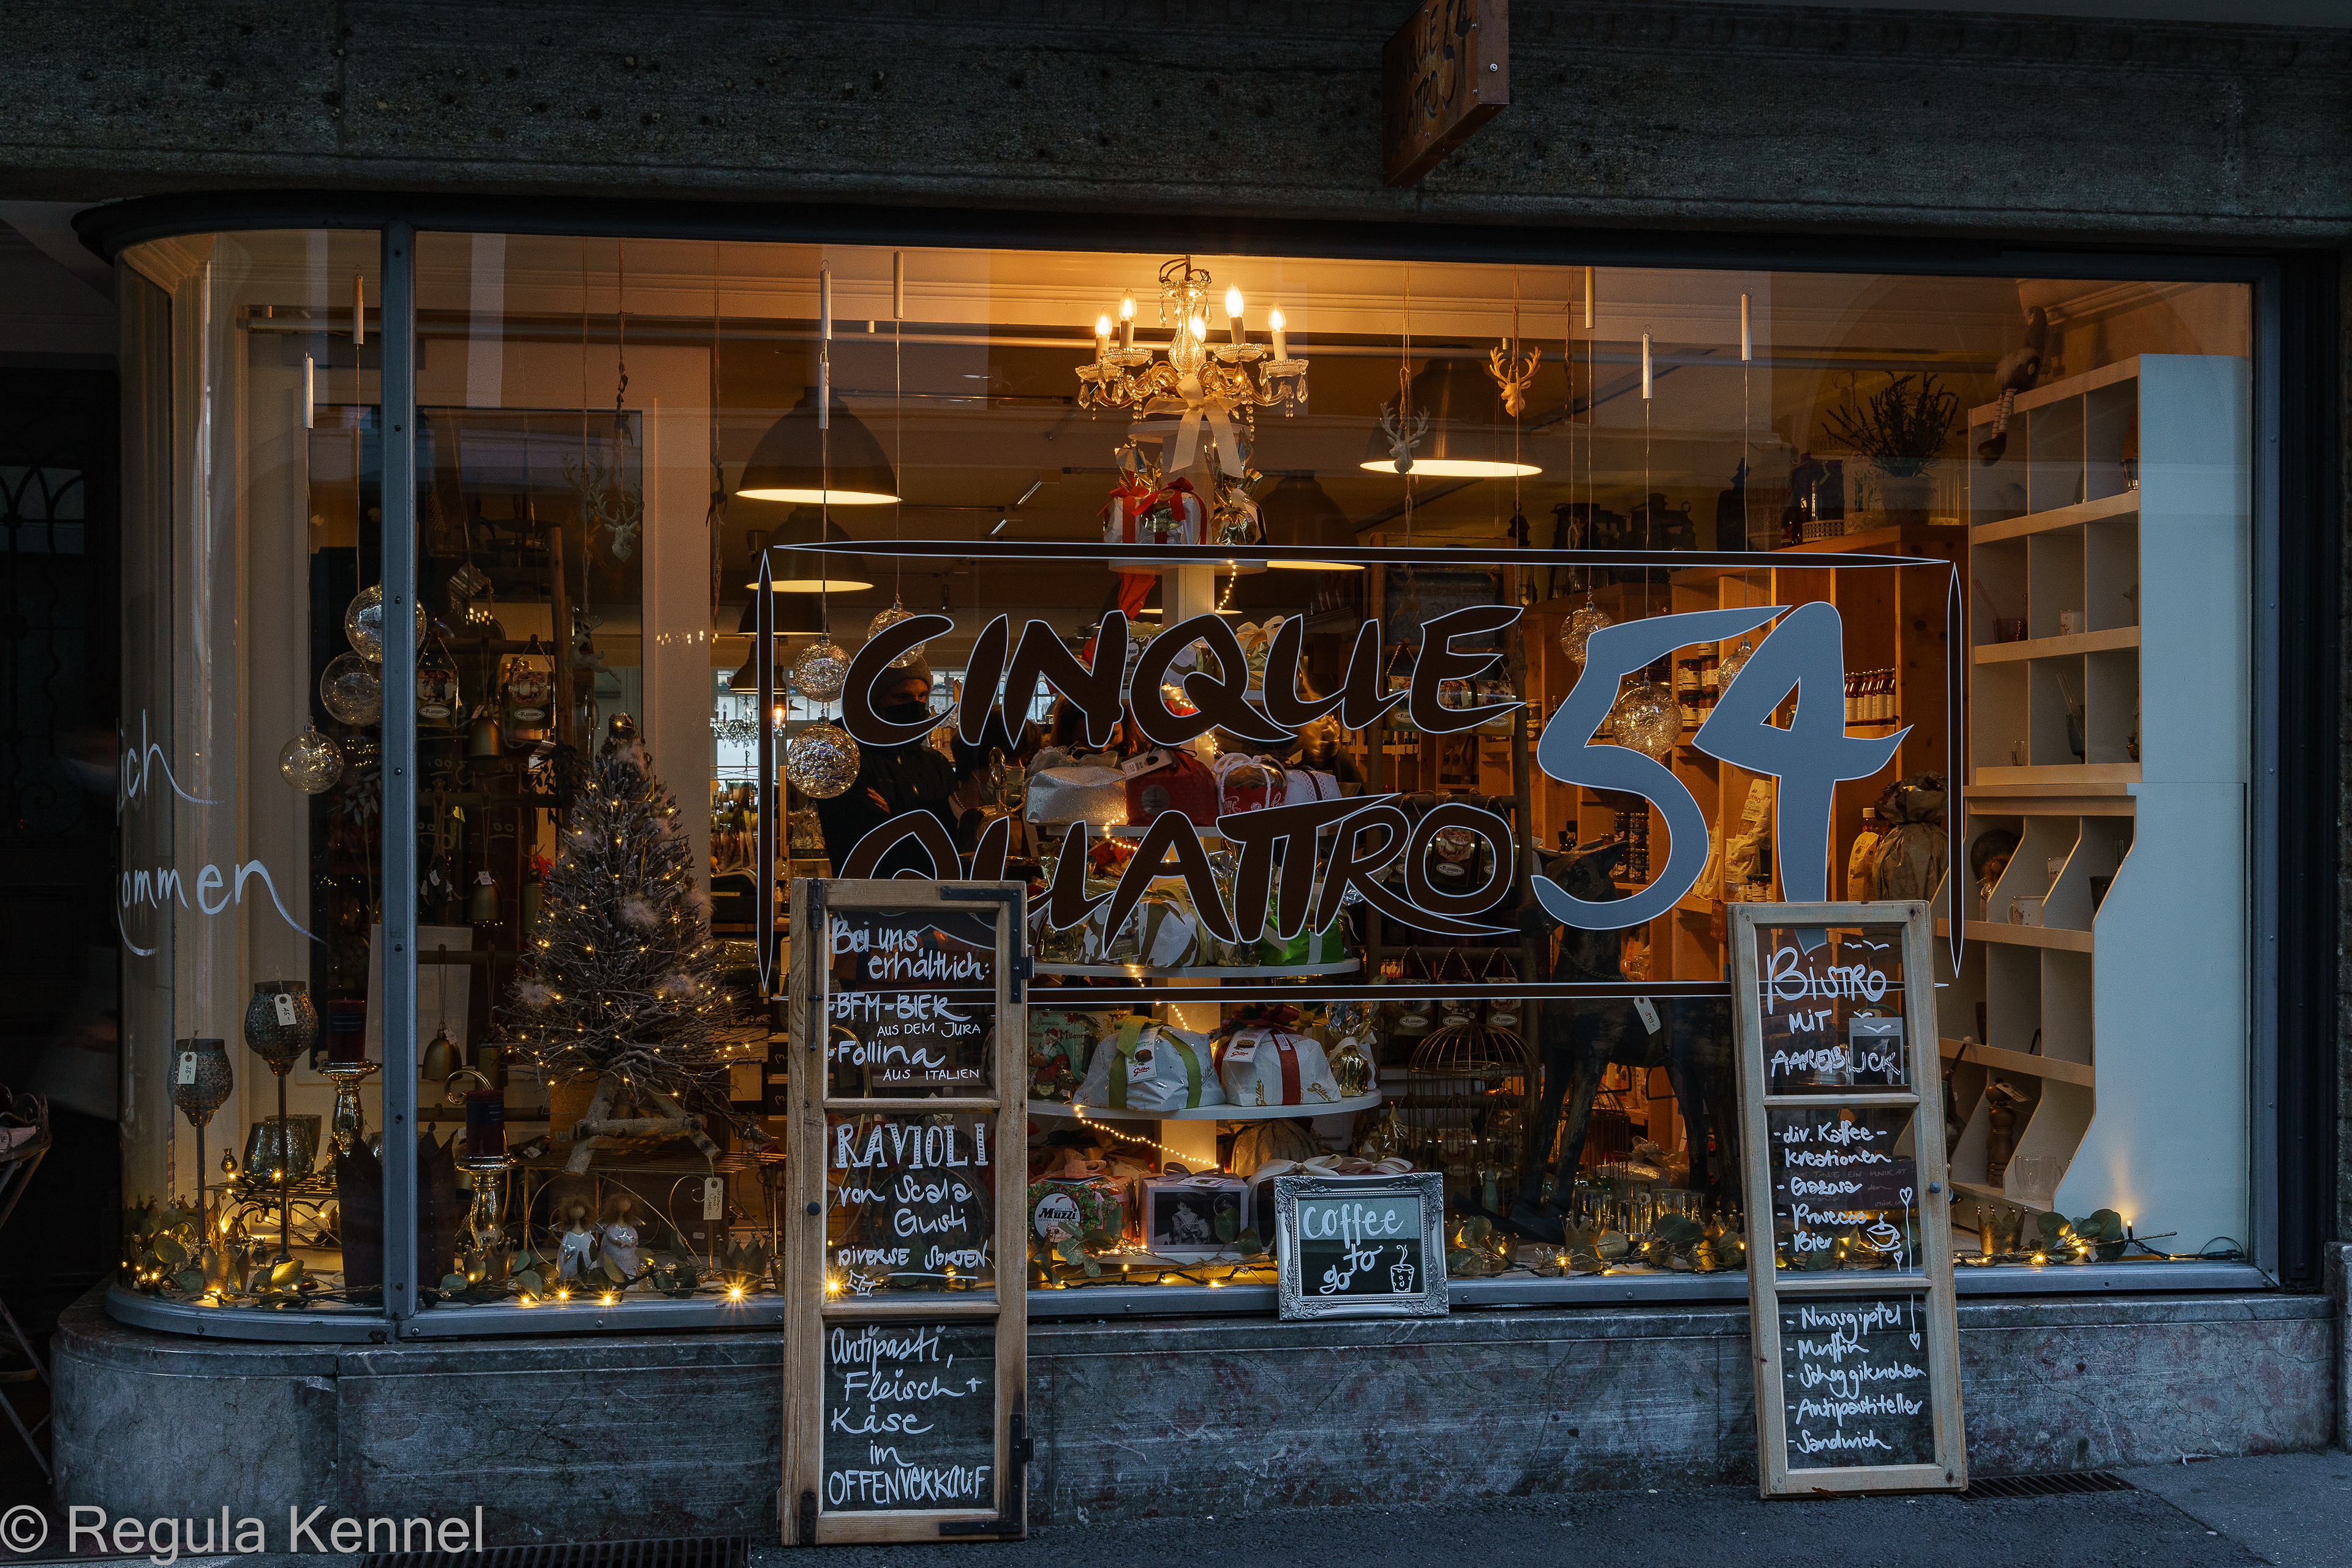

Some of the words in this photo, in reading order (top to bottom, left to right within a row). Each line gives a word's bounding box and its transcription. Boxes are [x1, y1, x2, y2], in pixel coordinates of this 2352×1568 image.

[840, 604, 1528, 750] CINQUE
[1535, 601, 1915, 949] 54
[834, 791, 1522, 959] QUATTRO
[116, 862, 332, 957] ommen
[831, 918, 870, 954] Bei
[879, 928, 918, 953] uns
[868, 949, 990, 981] erhältlich:
[876, 1025, 899, 1038] AUS
[904, 1022, 935, 1035] DEM
[941, 1022, 981, 1038] JURA
[837, 1039, 946, 1068] Follina
[883, 1069, 911, 1081] AUS
[925, 1068, 979, 1080] ITALIEN
[1256, 1077, 1268, 1106] Gilber
[1306, 1082, 1332, 1102] Gilber
[835, 1123, 989, 1169] RAVIOLI
[839, 1186, 885, 1207] von
[895, 1175, 973, 1204] Scala
[894, 1205, 967, 1237] Gusti
[1038, 1207, 1077, 1219] Muzzi
[1792, 1204, 1868, 1231] Prosecco
[1793, 1231, 1833, 1252] Bier
[1343, 1243, 1384, 1272] to
[1319, 1264, 1355, 1294] go
[1798, 1330, 1869, 1363] Muffin
[844, 1368, 966, 1401] Fleisch
[831, 1404, 935, 1434] Käse
[870, 1439, 915, 1467] im
[1796, 1429, 1892, 1454] Sandwich
